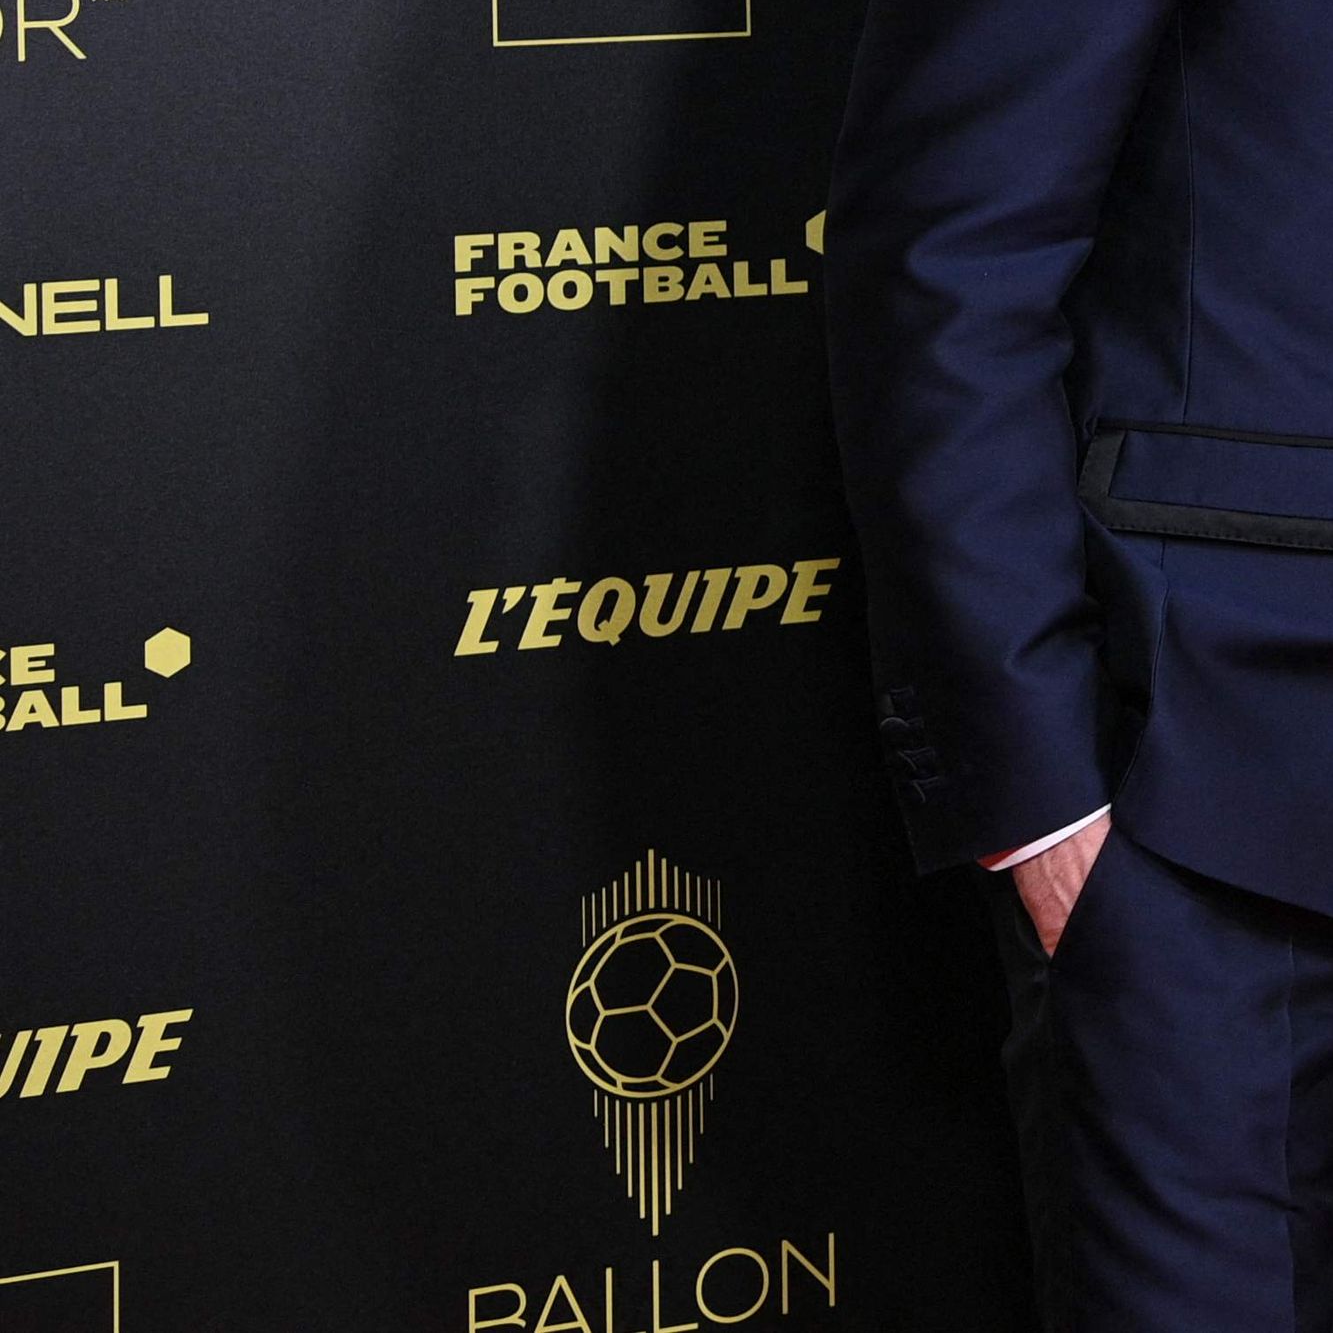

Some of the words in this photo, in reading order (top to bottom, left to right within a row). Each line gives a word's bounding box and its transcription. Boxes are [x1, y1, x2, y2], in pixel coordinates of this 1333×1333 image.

[455, 221, 726, 273] FRANCE
[455, 259, 807, 315] FOOTBALL
[454, 560, 838, 656] L'ÉQUIPE
